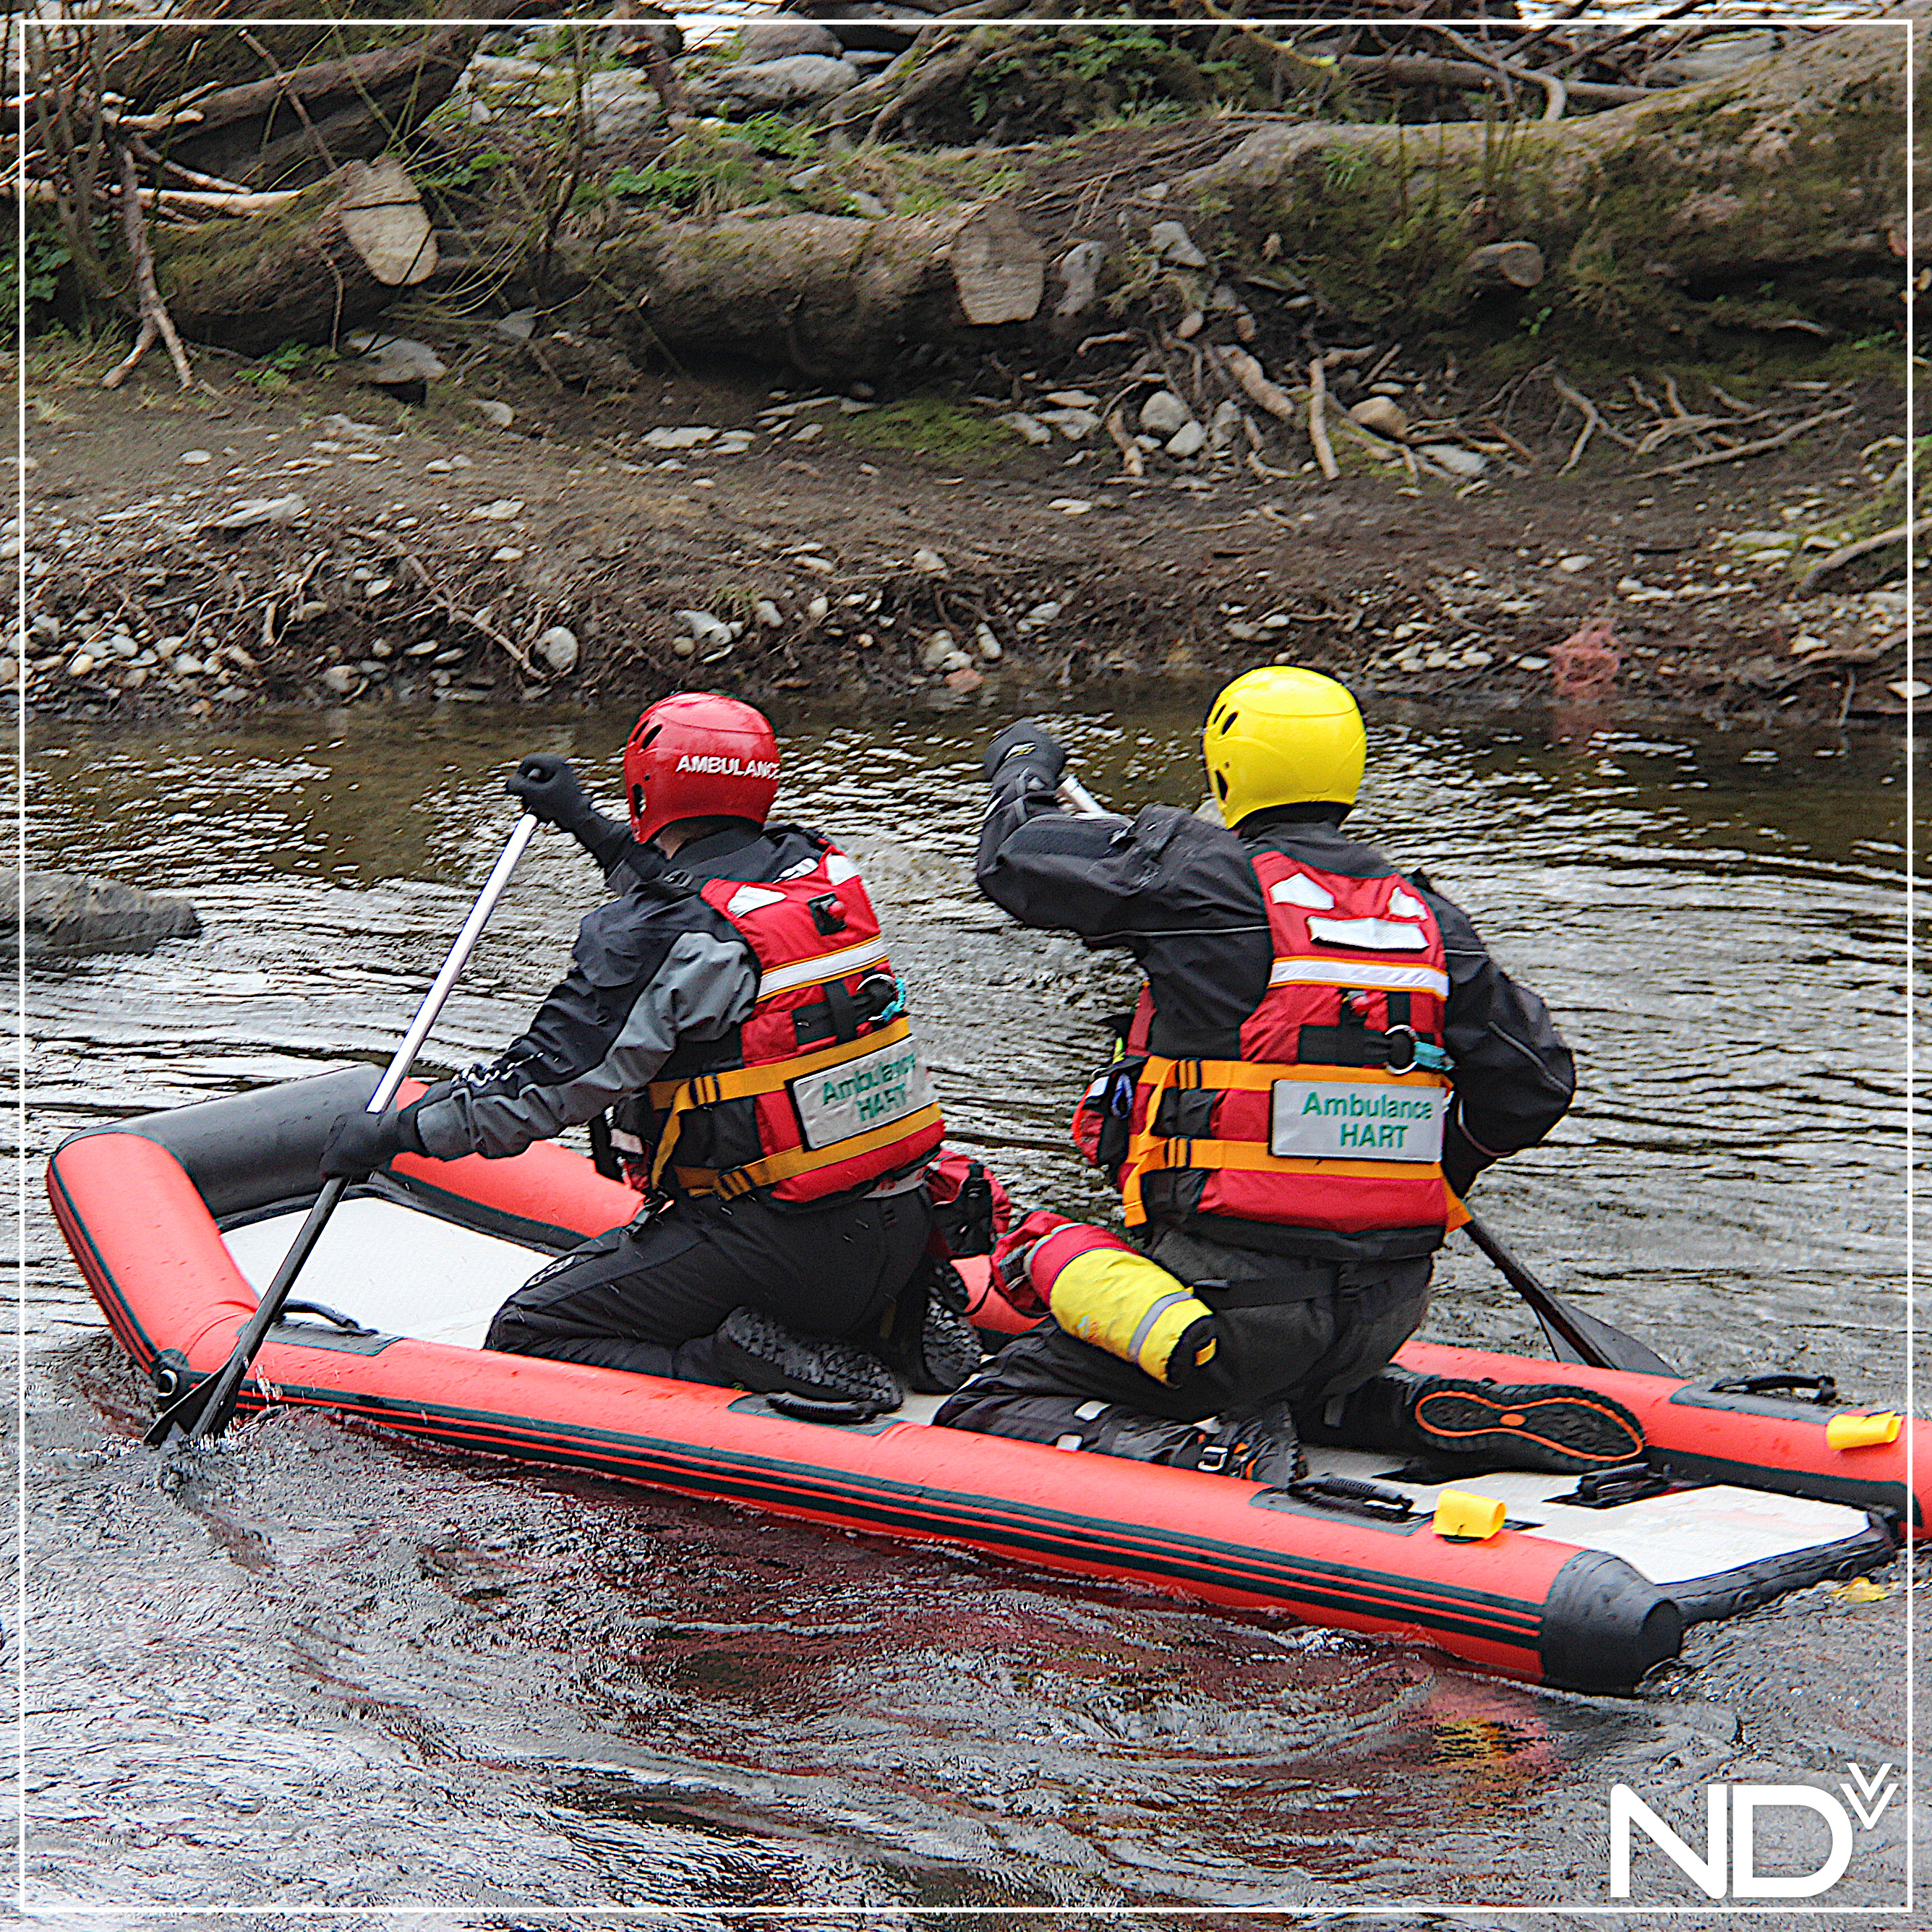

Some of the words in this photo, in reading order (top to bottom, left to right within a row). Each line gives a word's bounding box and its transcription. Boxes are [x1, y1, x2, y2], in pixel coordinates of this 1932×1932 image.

[855, 1082, 907, 1121] HART
[1301, 1092, 1432, 1120] Ambulance
[1340, 1123, 1409, 1148] HART
